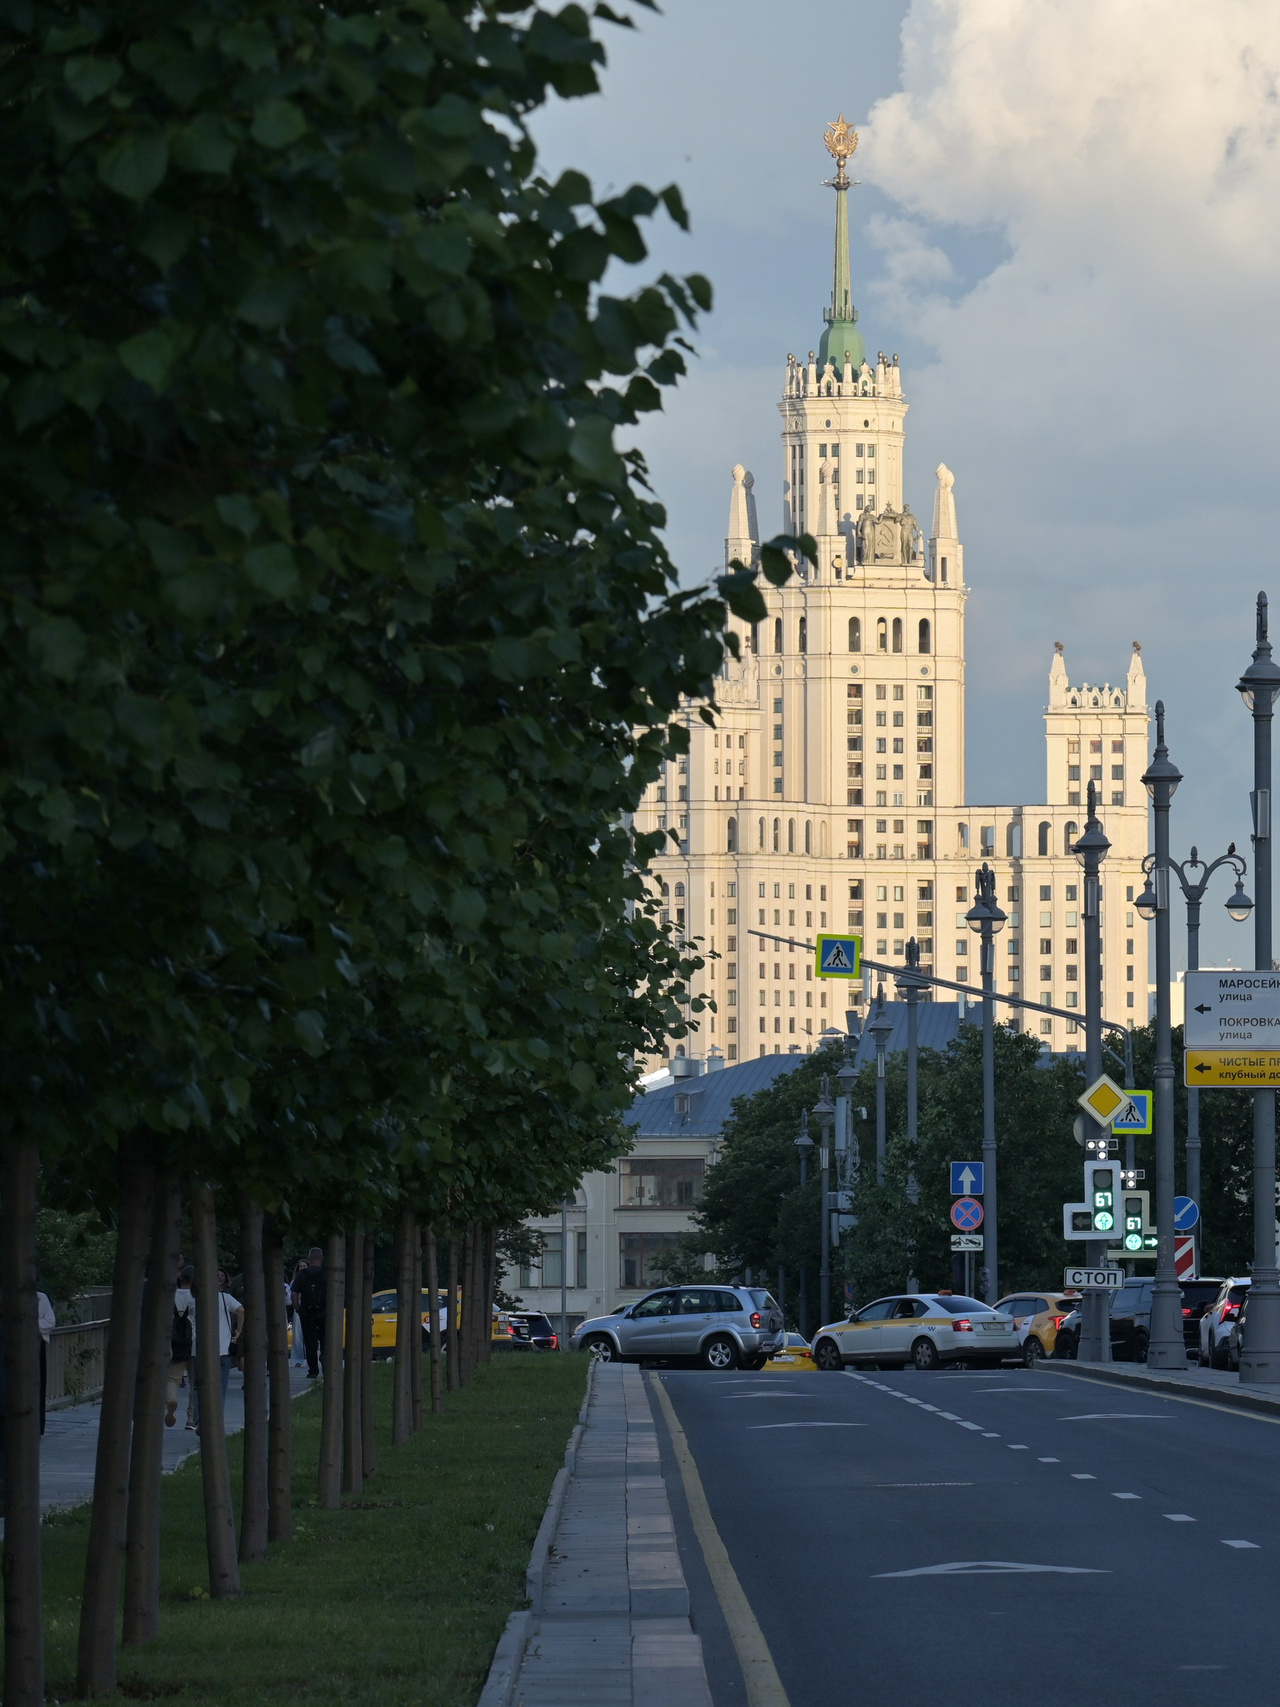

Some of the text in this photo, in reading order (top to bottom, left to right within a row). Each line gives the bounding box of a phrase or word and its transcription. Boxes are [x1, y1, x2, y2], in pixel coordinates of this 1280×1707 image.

[1219, 993, 1253, 1003] улица
[1219, 1032, 1253, 1041] улица
[1219, 1057, 1265, 1067] ЧИСТЫЕ
[1219, 1070, 1266, 1081] клубный
[1095, 1191, 1112, 1207] 67
[1127, 1217, 1141, 1230] 67
[1071, 1271, 1117, 1286] СТОП
